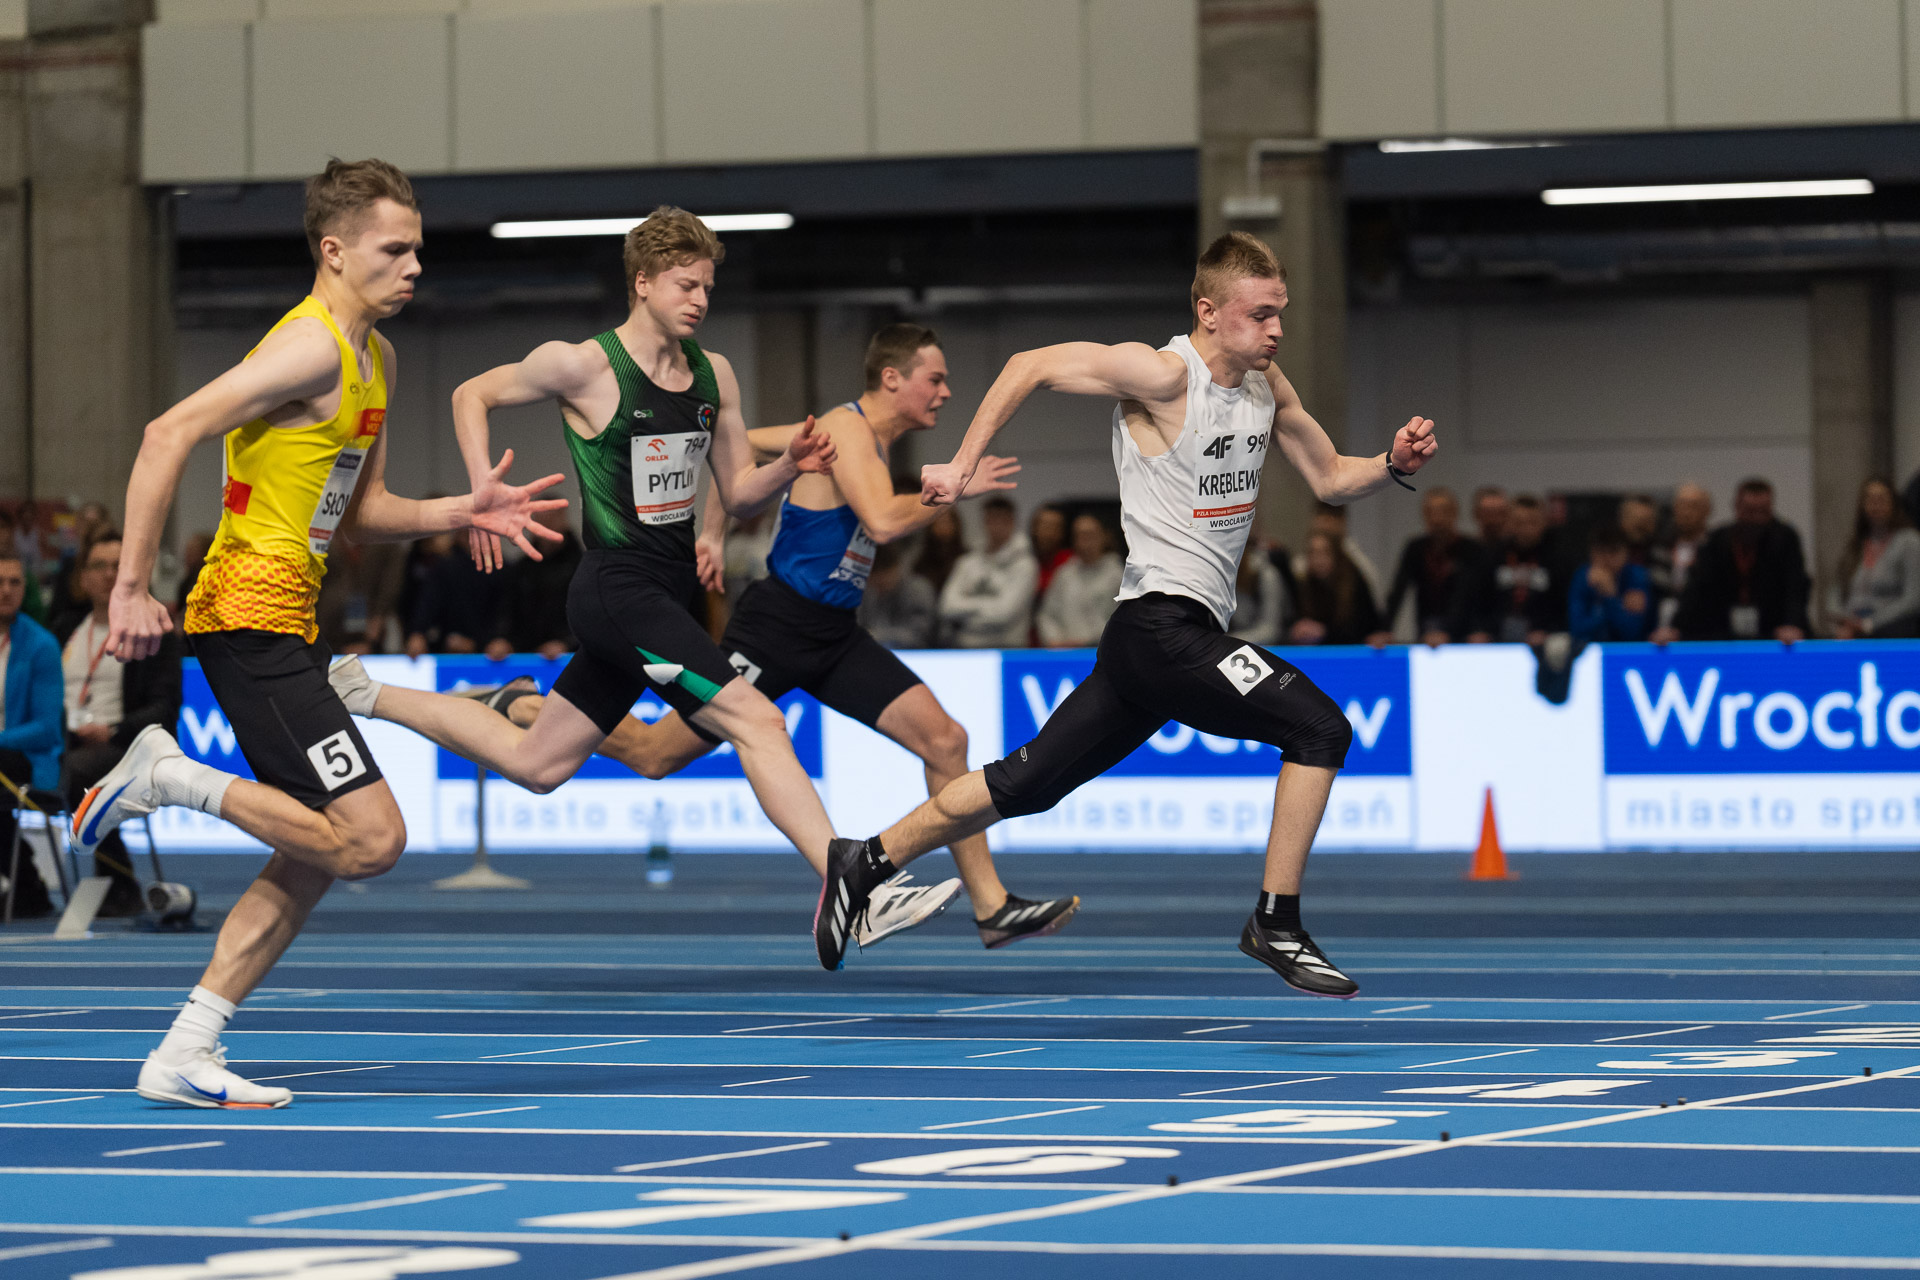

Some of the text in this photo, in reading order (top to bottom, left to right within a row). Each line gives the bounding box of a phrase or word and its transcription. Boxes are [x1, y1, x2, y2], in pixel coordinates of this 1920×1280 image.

[685, 437, 708, 455] 794
[1203, 431, 1268, 460] 4F 990
[1230, 653, 1262, 684] 3
[321, 738, 354, 778] 5
[1625, 791, 1796, 830] miasto
[1596, 1050, 1839, 1070] 3
[1381, 1079, 1653, 1100] 4
[1147, 1108, 1450, 1134] 5
[853, 1145, 1181, 1177] 6
[518, 1187, 907, 1229] 7
